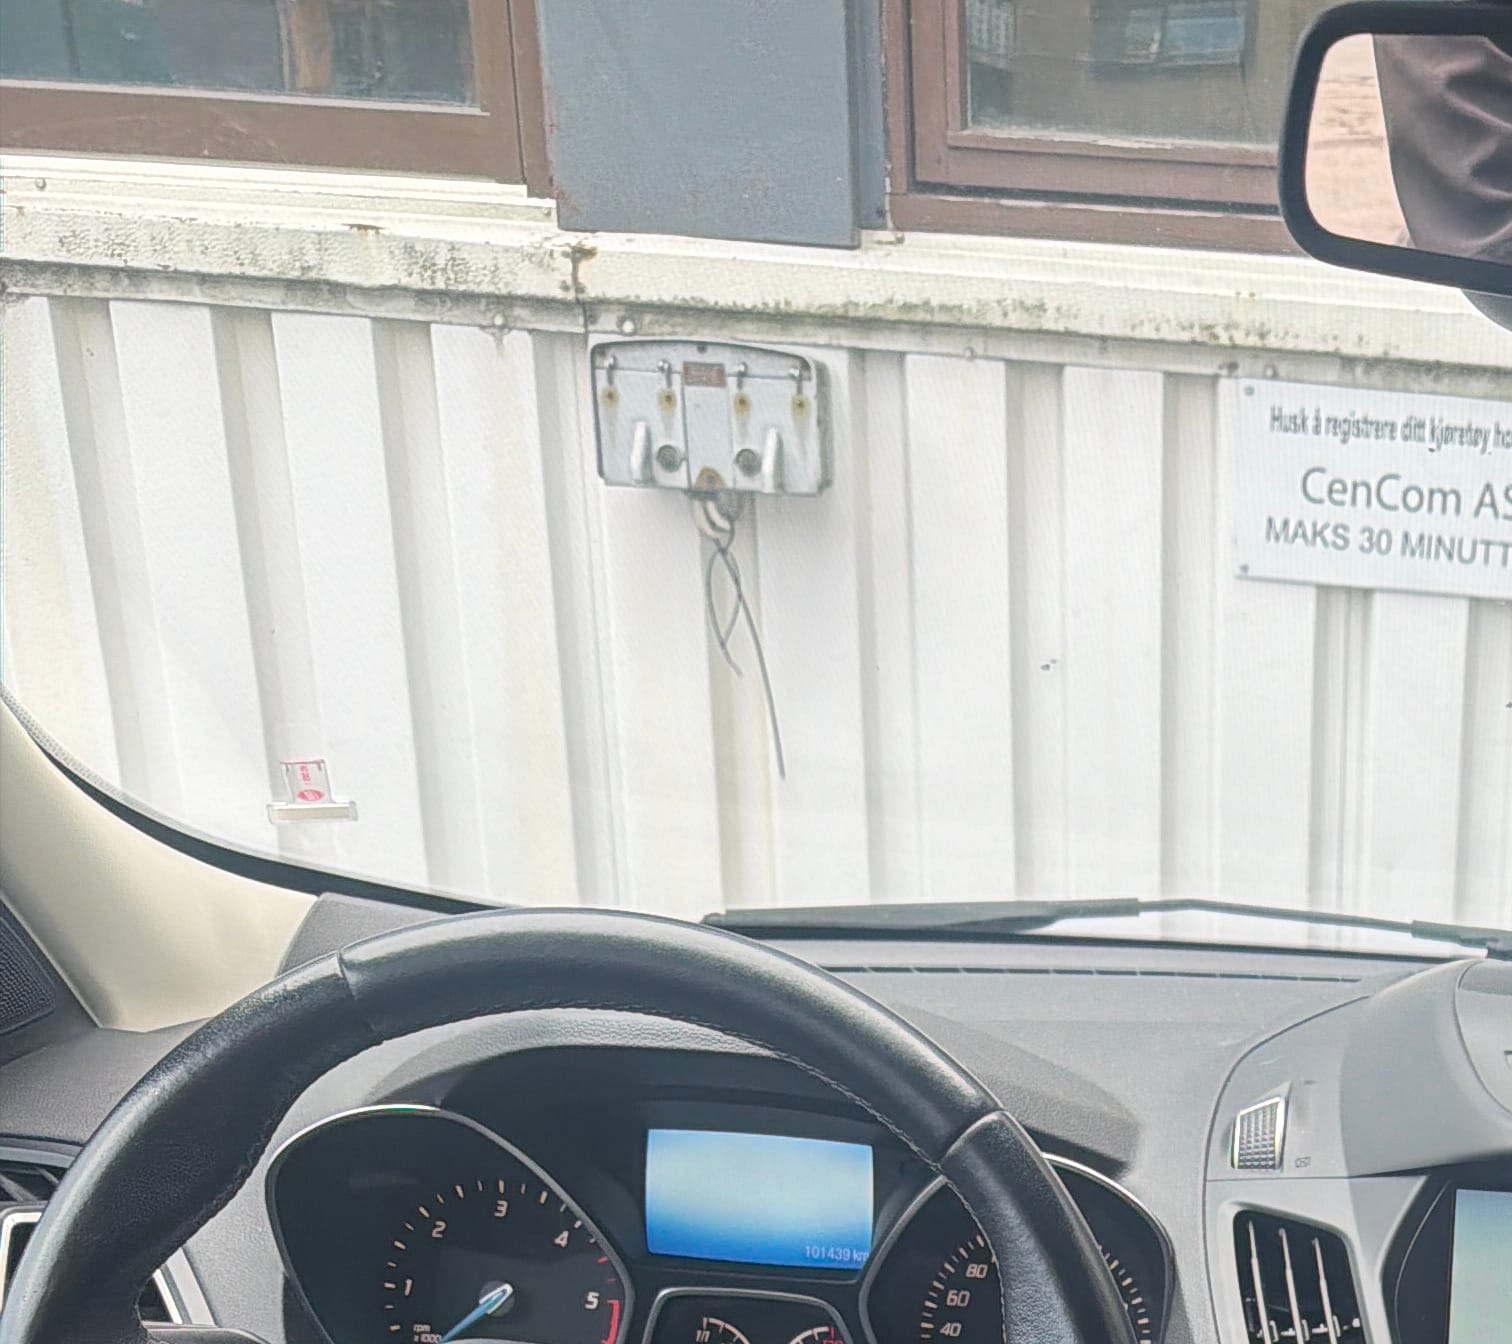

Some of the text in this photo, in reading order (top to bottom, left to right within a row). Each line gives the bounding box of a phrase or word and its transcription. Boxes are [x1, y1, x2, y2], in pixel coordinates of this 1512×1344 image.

[1269, 406, 1308, 434] Husk
[1312, 406, 1321, 436] å
[1325, 409, 1397, 445] registrere
[1401, 414, 1426, 443] ditt
[1301, 467, 1461, 517] CenCom
[1265, 517, 1350, 551] MAKS
[1359, 528, 1393, 556] 30
[494, 1200, 508, 1217] 3
[431, 1221, 447, 1238] 2
[554, 1230, 569, 1248] 4
[805, 1245, 850, 1260] 101439
[965, 1263, 988, 1279] 80
[404, 1279, 413, 1296] 1
[585, 1291, 600, 1310] 5
[946, 1290, 970, 1307] 60
[939, 1322, 962, 1337] 40
